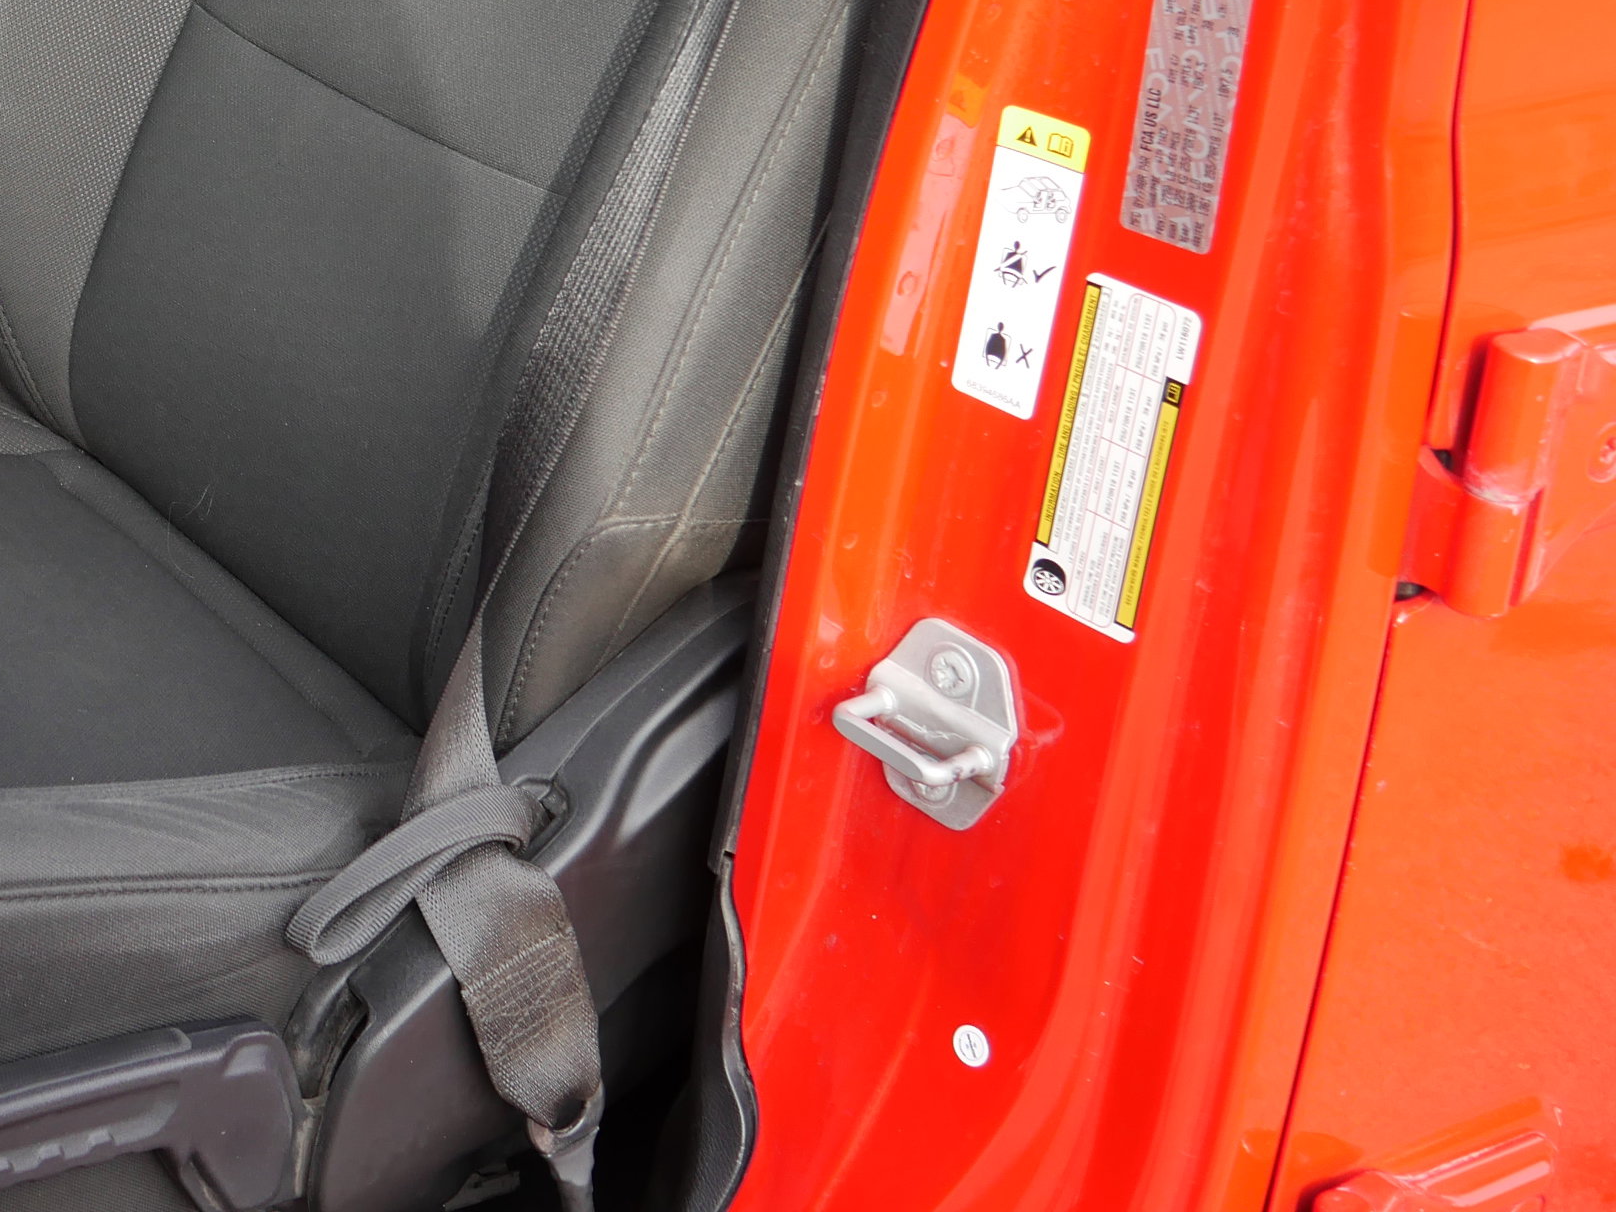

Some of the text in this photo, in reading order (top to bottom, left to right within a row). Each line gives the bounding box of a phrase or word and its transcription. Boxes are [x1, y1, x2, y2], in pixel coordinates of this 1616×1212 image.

[1145, 86, 1161, 109] LLC
[1142, 110, 1157, 128] US
[1185, 103, 1200, 125] 113T
[1211, 111, 1225, 132] 113T
[1139, 128, 1155, 152] FCA
[1080, 293, 1098, 346] CHARGEMENT
[1175, 315, 1192, 360] LW116072
[1078, 347, 1087, 357] ET
[1072, 356, 1085, 384] PNEUS
[1064, 389, 1078, 423] LOADING
[1060, 423, 1070, 441] AND
[1056, 442, 1067, 459] TIRE
[1043, 470, 1061, 522] INFORMATION
